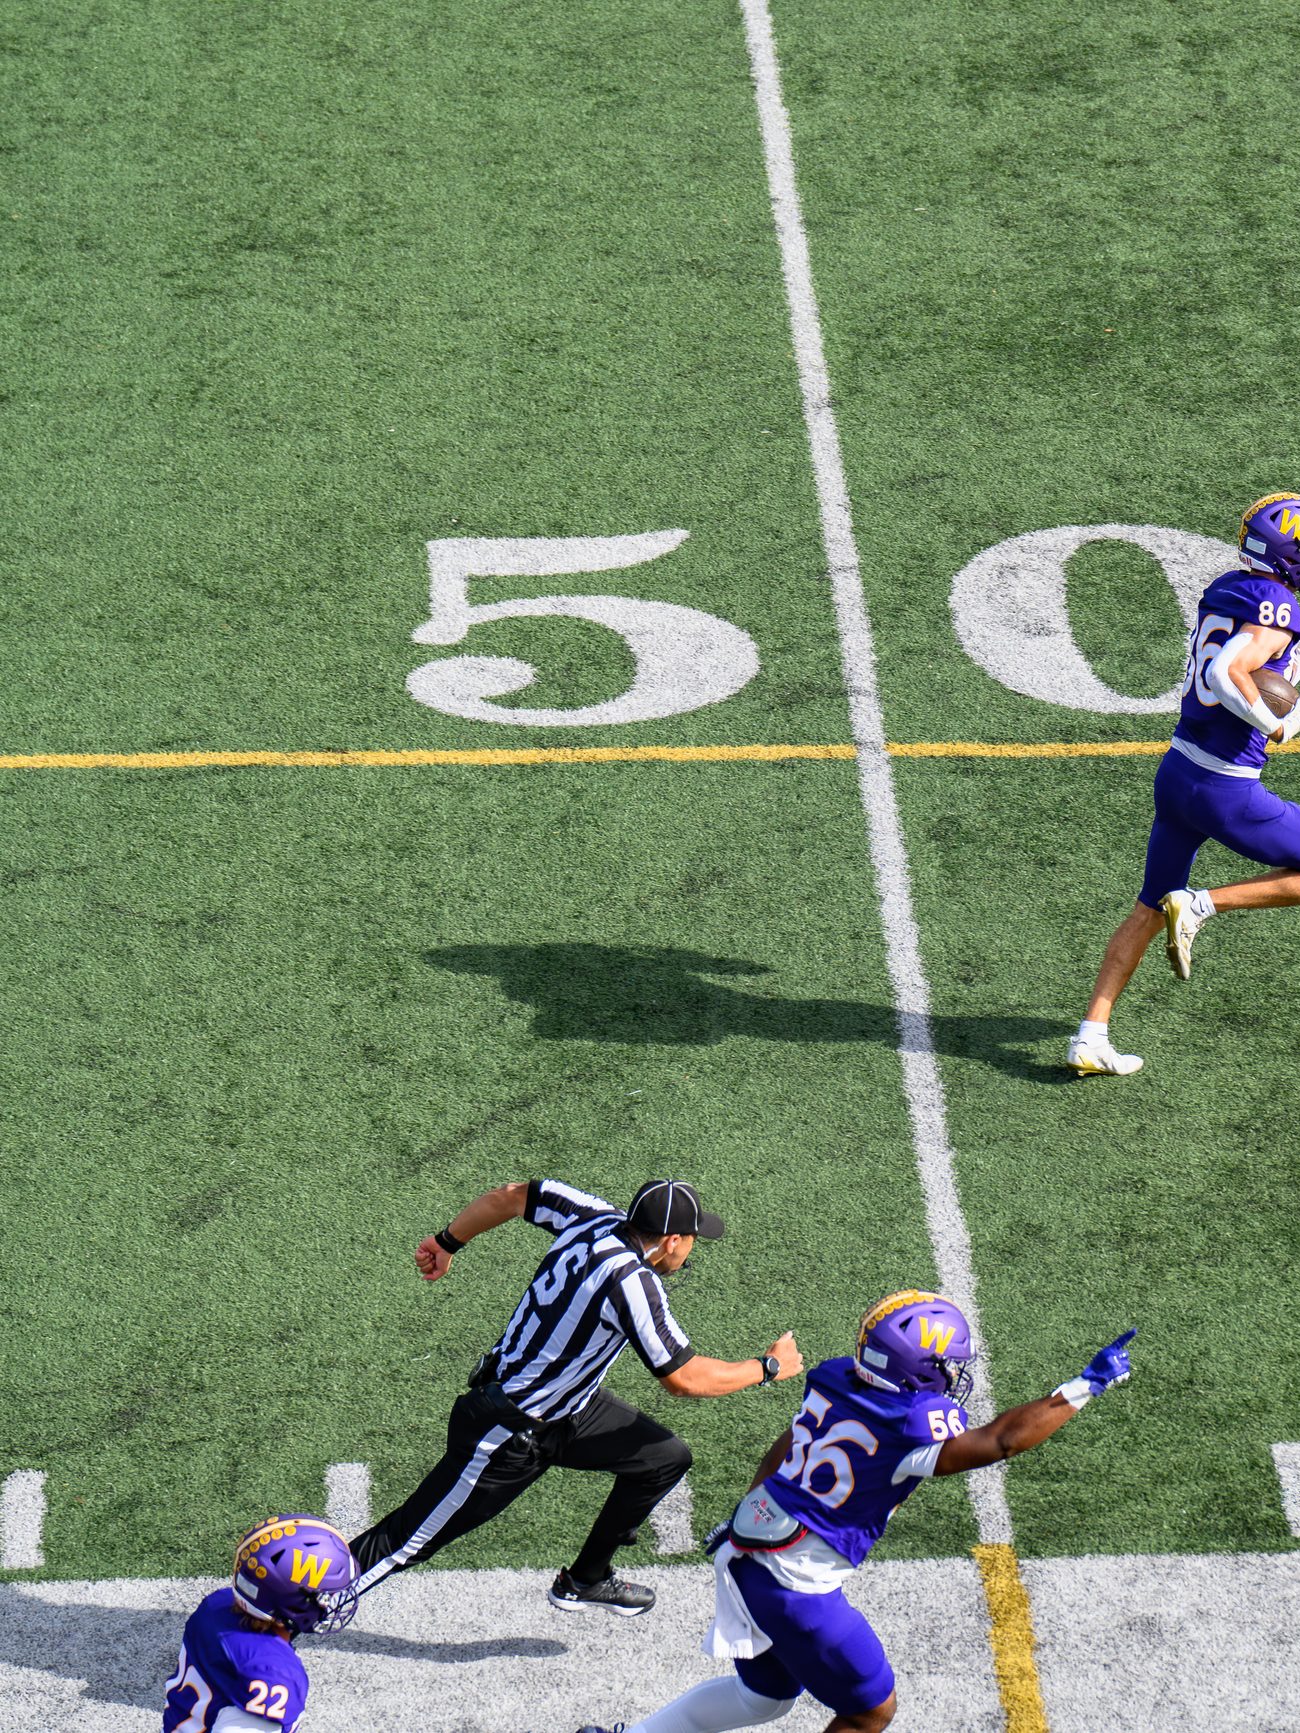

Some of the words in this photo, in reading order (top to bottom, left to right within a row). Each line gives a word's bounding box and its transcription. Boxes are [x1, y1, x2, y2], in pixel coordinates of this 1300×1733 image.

[1258, 600, 1292, 627] 86
[1181, 613, 1235, 707] 6
[532, 1242, 589, 1306] S
[919, 1316, 956, 1355] W
[927, 1408, 966, 1441] 56
[777, 1388, 879, 1509] 56
[290, 1548, 332, 1589] W
[245, 1679, 290, 1719] 22
